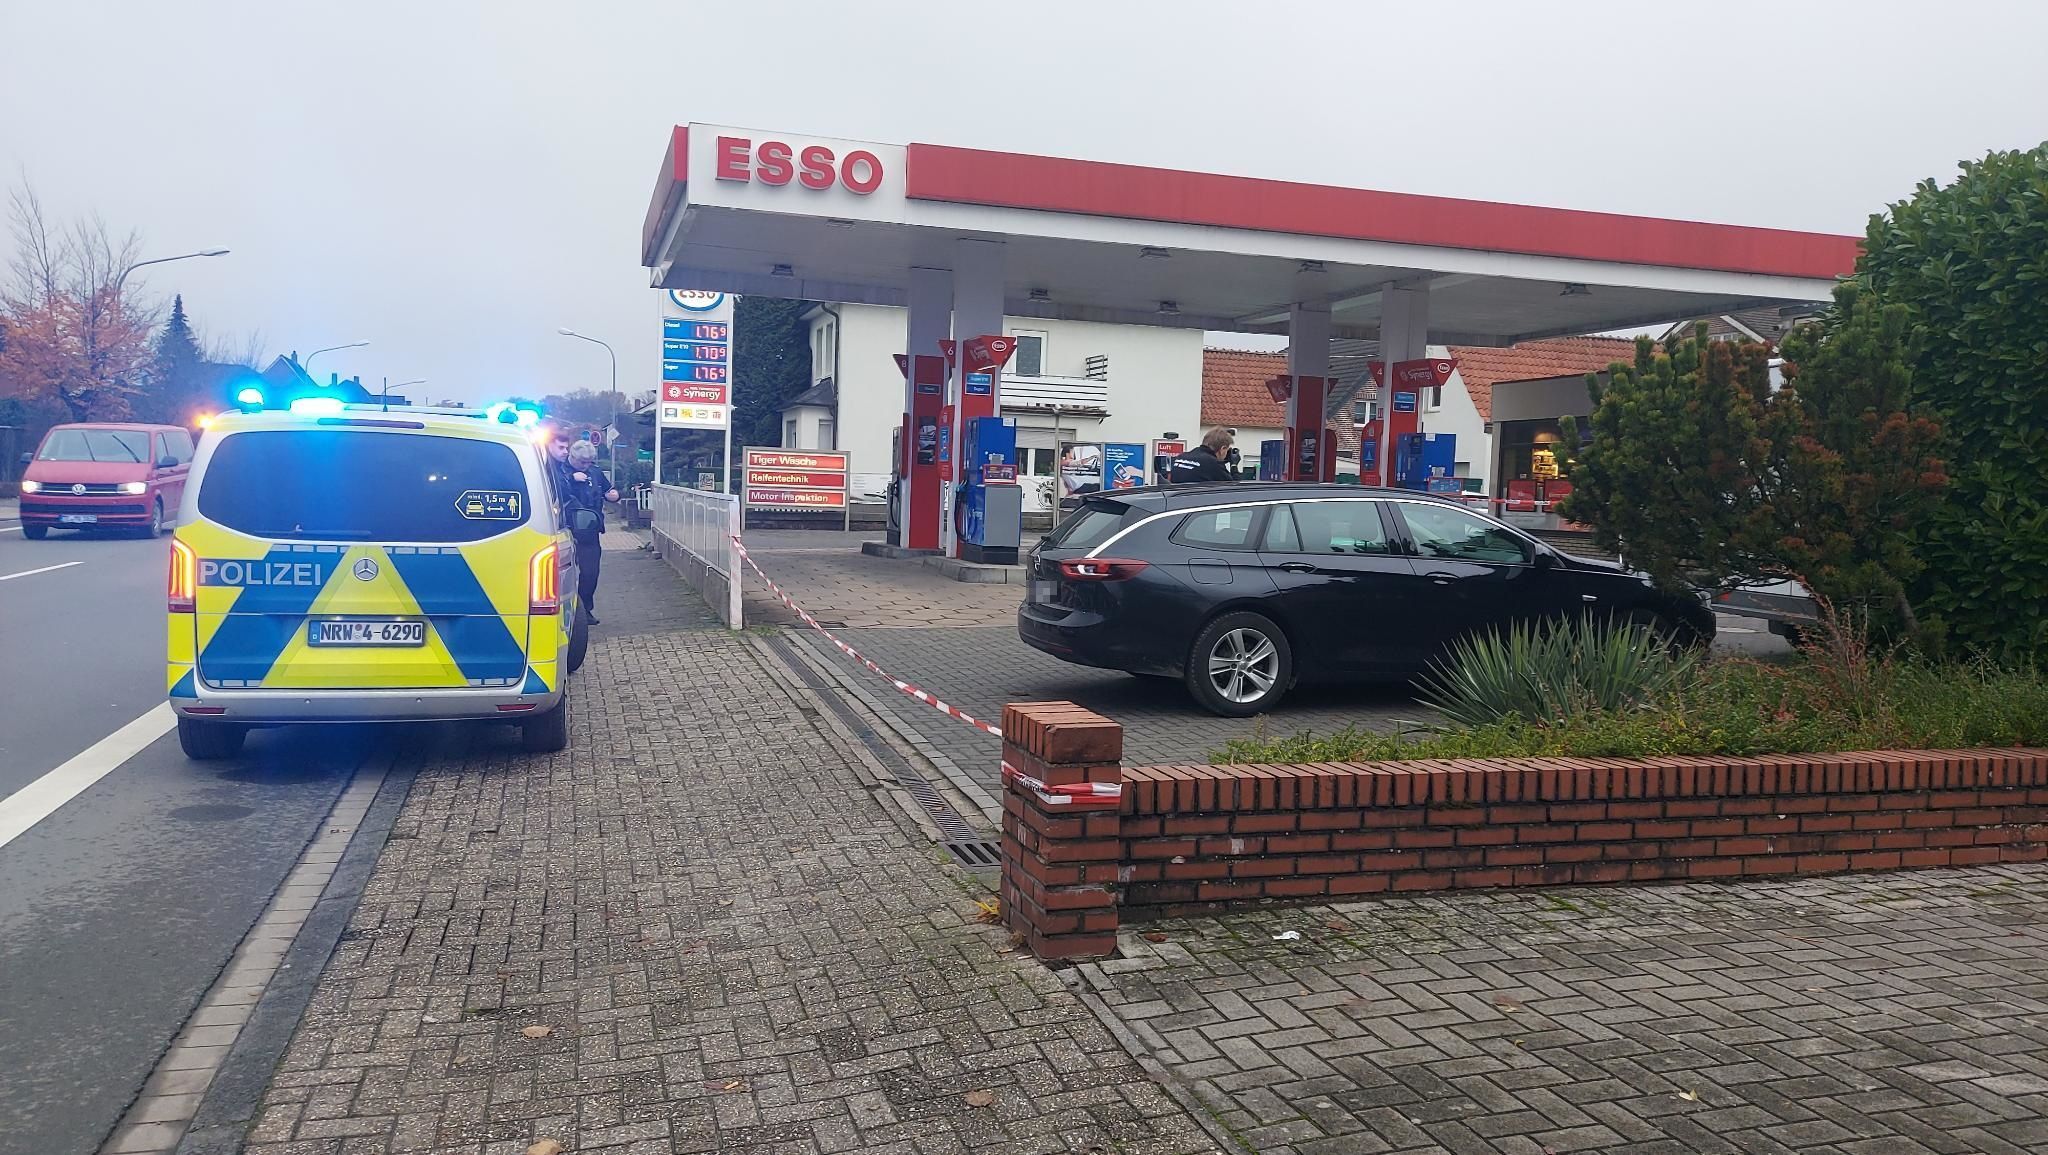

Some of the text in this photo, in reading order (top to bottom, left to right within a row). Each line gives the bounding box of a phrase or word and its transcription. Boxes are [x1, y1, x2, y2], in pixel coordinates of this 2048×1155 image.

[715, 136, 884, 195] ESSO
[947, 346, 954, 356] 6
[1376, 367, 1383, 375] 4
[683, 388, 721, 400] Synergy
[752, 454, 817, 466] Tiger Wäsche
[751, 473, 809, 483] Reifentechnik
[484, 494, 498, 503] 1,5
[751, 492, 829, 503] Motor Inspektion
[199, 561, 321, 586] POLIZEI
[320, 623, 422, 641] NRW 4-6290
